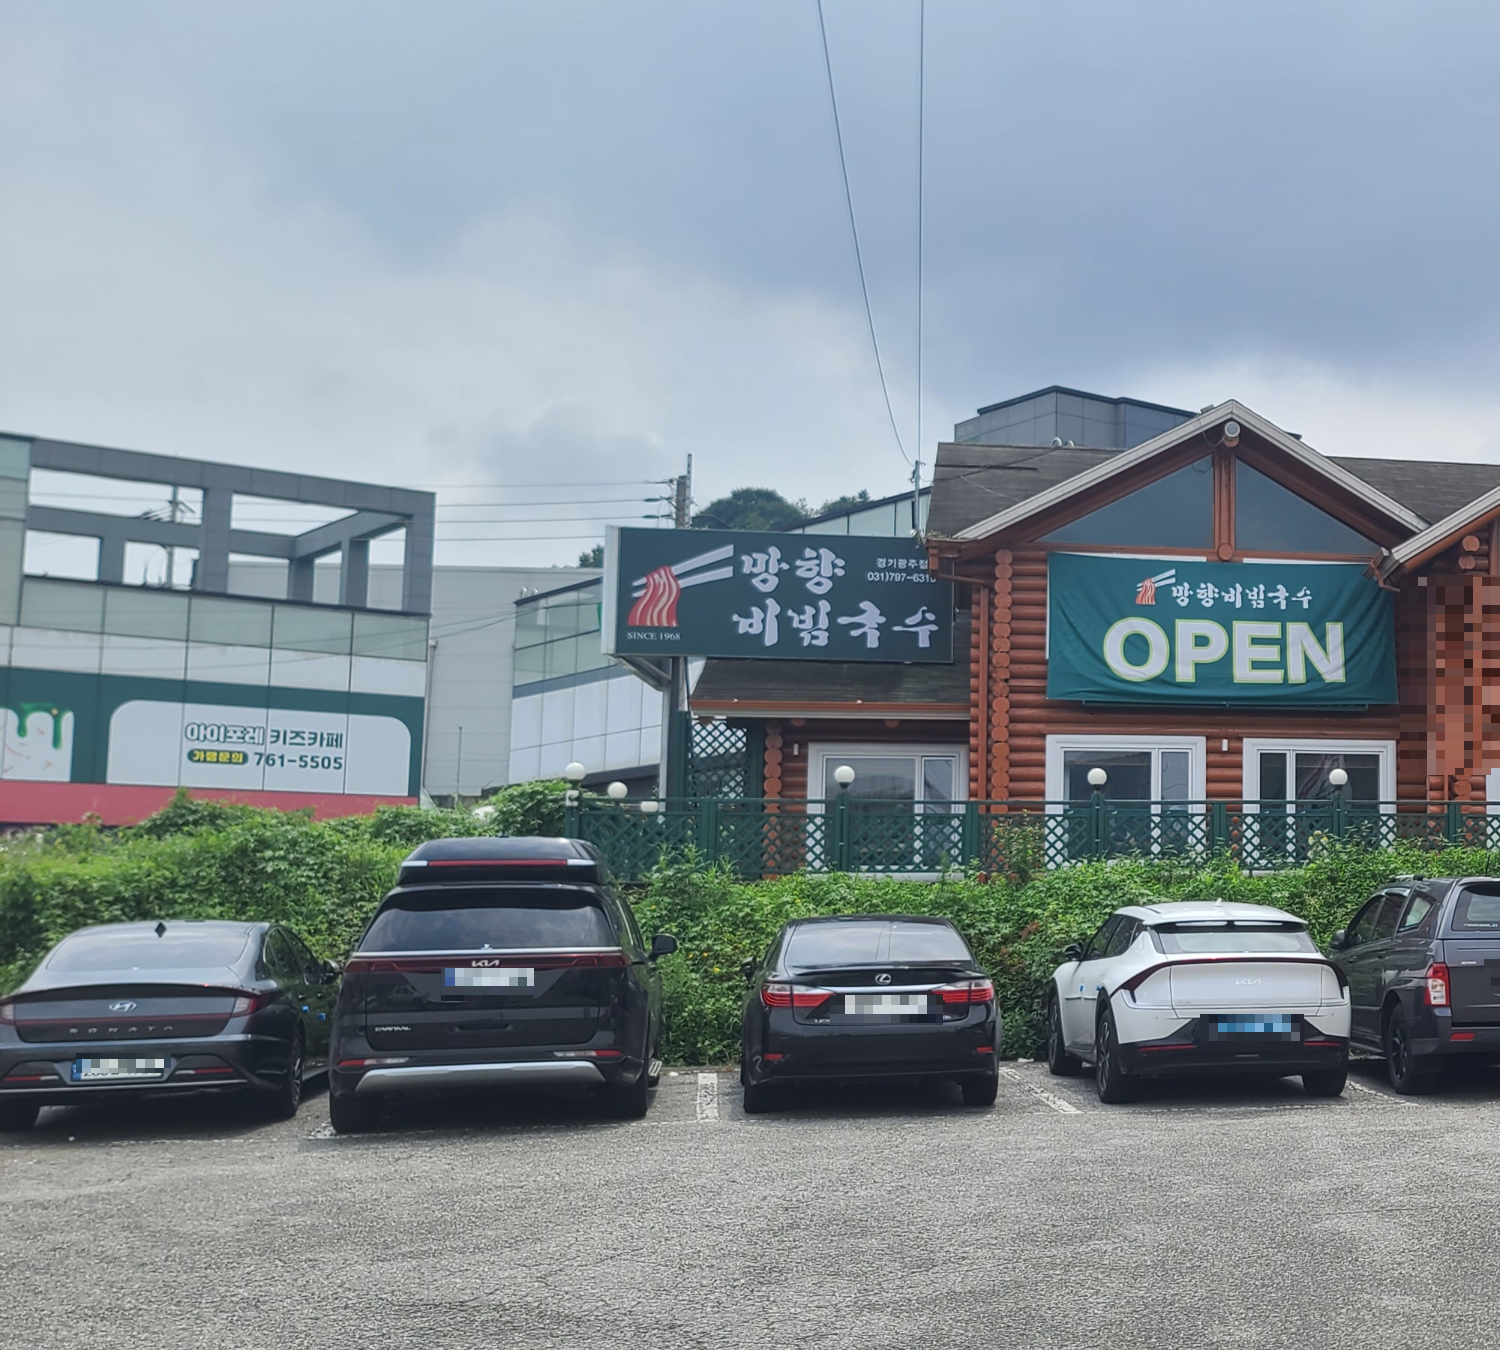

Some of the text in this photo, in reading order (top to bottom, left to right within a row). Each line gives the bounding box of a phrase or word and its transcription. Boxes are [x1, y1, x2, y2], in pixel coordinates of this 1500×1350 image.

[741, 546, 846, 595] 망향
[877, 558, 928, 569] 경기광주점
[627, 631, 681, 640] SINCE 1968
[732, 598, 940, 649] 비빔국수
[1103, 616, 1347, 684] OPEN
[185, 722, 343, 749] 아이포레 키즈카페
[254, 752, 343, 770] 761-5505
